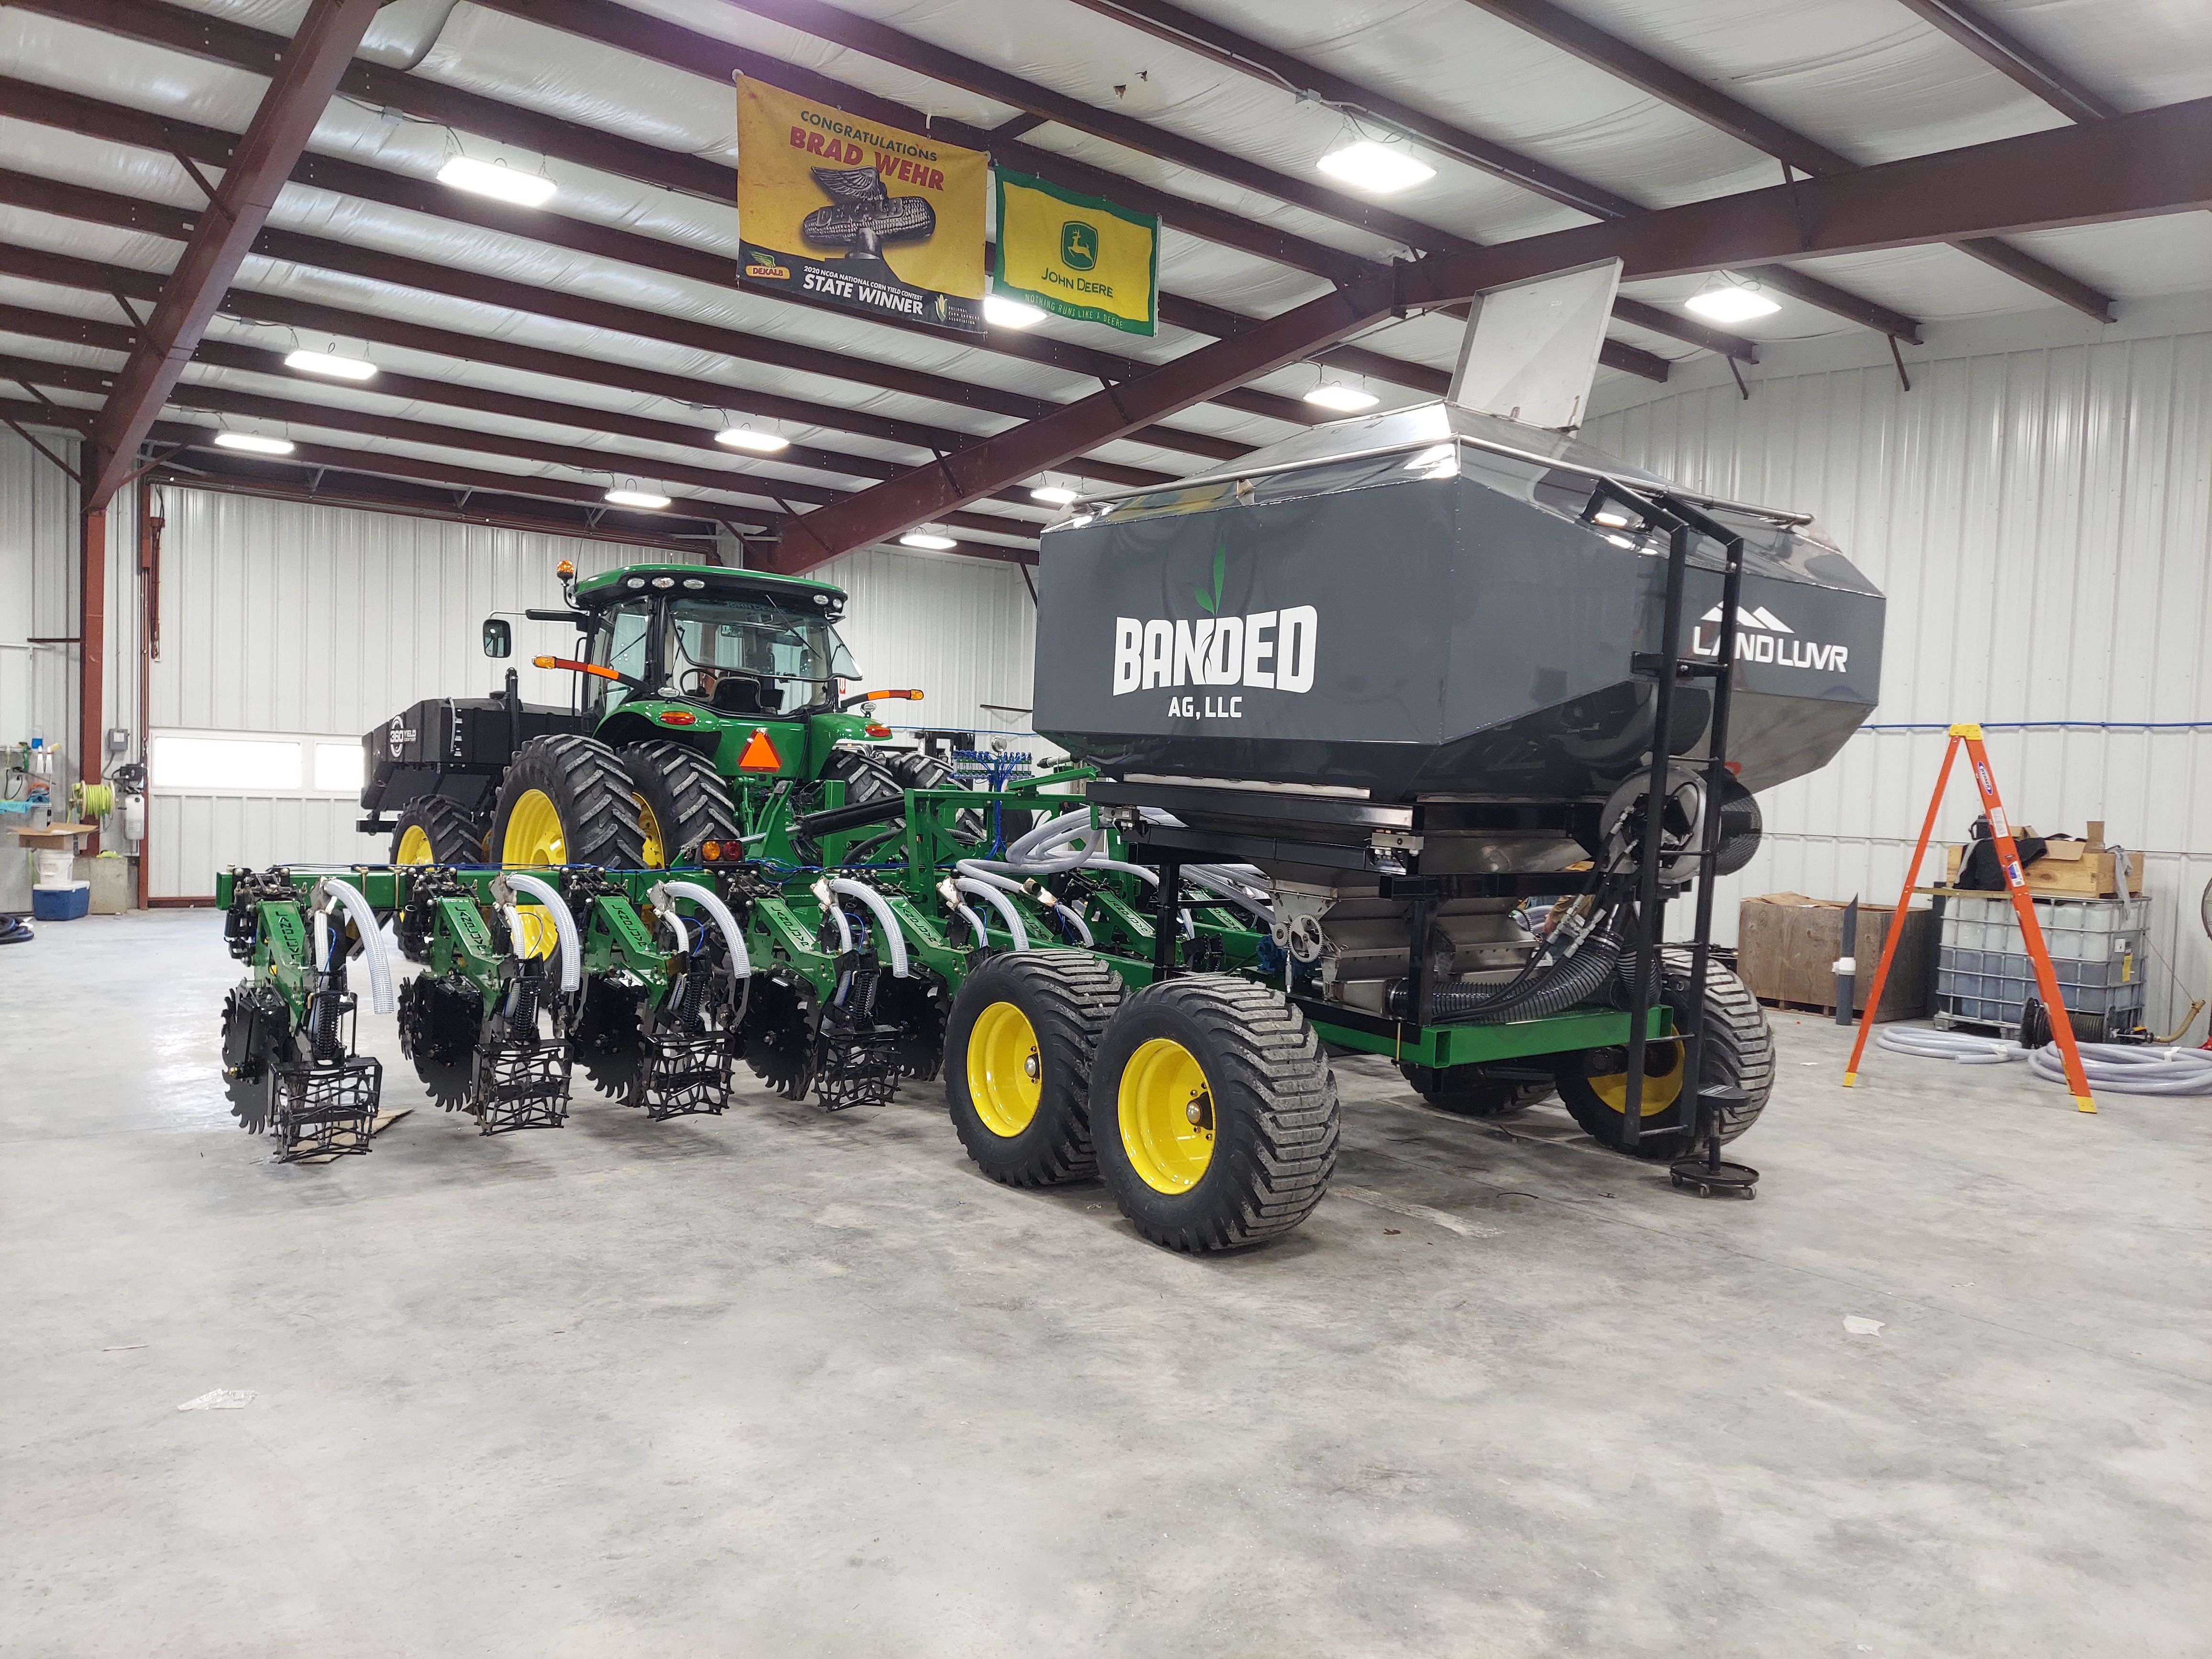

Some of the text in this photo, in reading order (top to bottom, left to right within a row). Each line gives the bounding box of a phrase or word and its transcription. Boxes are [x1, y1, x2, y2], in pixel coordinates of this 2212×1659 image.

[801, 111, 938, 162] CONGRATULATIONS
[790, 126, 944, 191] BRAD WEHR
[752, 267, 784, 276] DEKALB
[804, 266, 923, 301] 2020 NCGA NATIONAL CORN YIELD CONTEST
[1041, 267, 1113, 298] JOHN DEERE
[803, 274, 923, 315] STATE WINNER
[1025, 293, 1055, 310] NOTHING
[1058, 304, 1075, 317] RUNS
[1078, 310, 1093, 319] LIKE
[1104, 314, 1124, 329] DEERE
[1113, 605, 1317, 696] BANDED
[1168, 697, 1242, 720] AG, LLC
[390, 729, 417, 743] 360 YIELD
[611, 905, 647, 947] LANDLUVR
[771, 907, 810, 946] LANDLUVR
[896, 904, 938, 942] LANDLUVR
[1106, 898, 1148, 932] LANDLUVR
